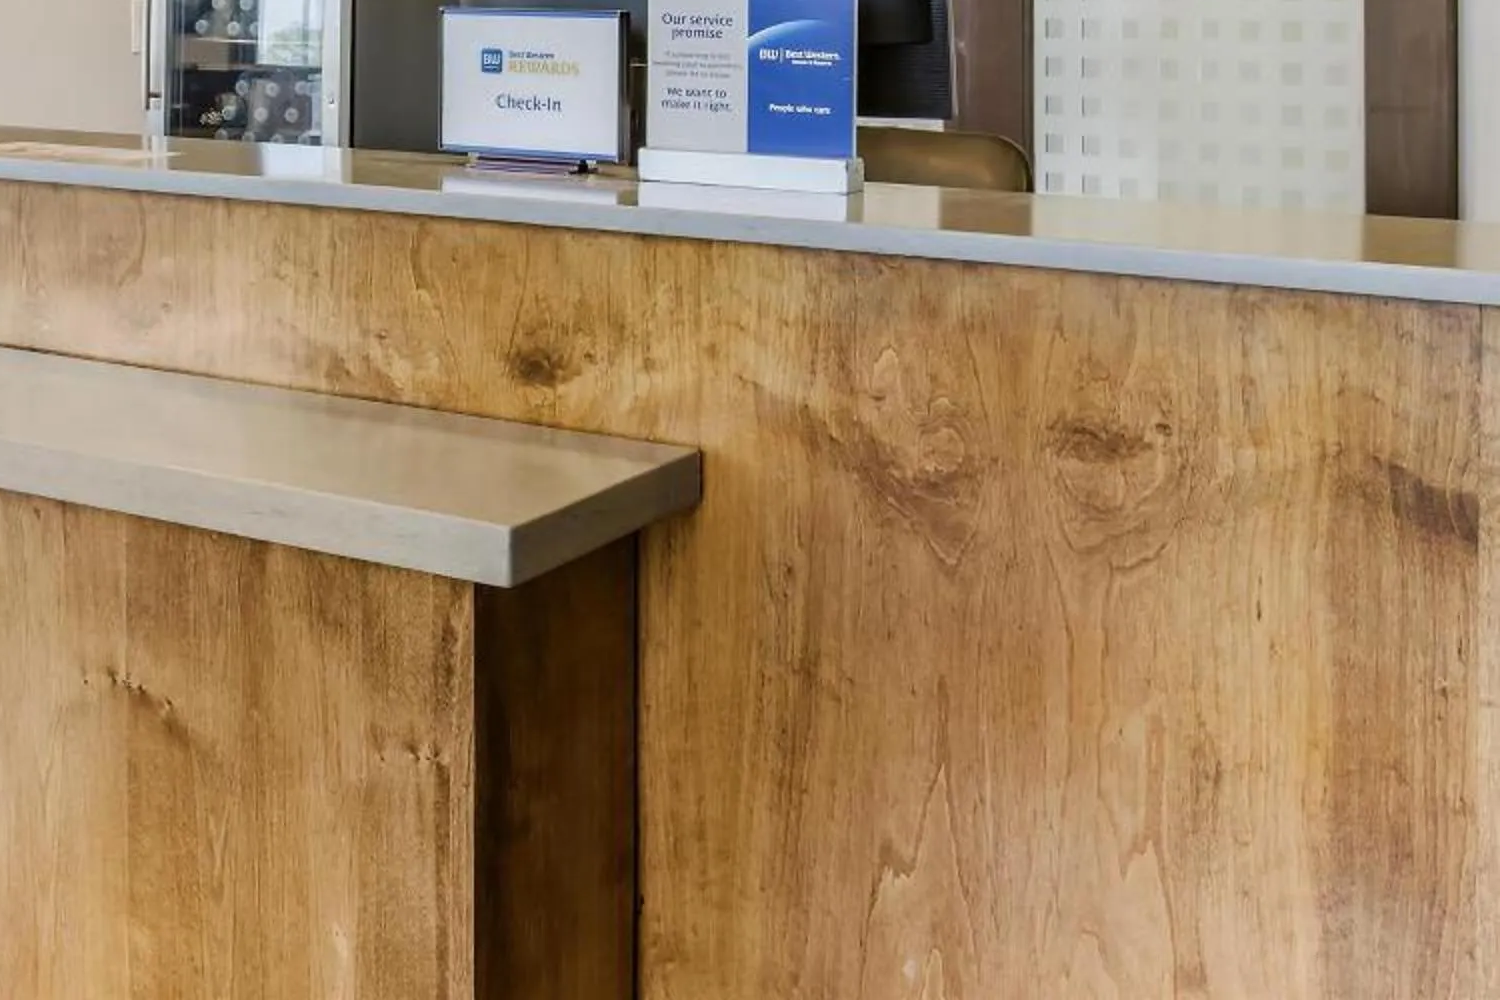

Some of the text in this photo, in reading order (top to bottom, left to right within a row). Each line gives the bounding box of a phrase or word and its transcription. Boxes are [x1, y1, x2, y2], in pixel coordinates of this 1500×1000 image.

[661, 12, 733, 27] Our service
[672, 28, 723, 40] promise
[483, 53, 501, 65] BW
[507, 60, 579, 76] REWARDS
[667, 87, 727, 98] We want to
[495, 94, 562, 112] Check-In
[661, 99, 690, 109] make
[693, 100, 701, 110] it
